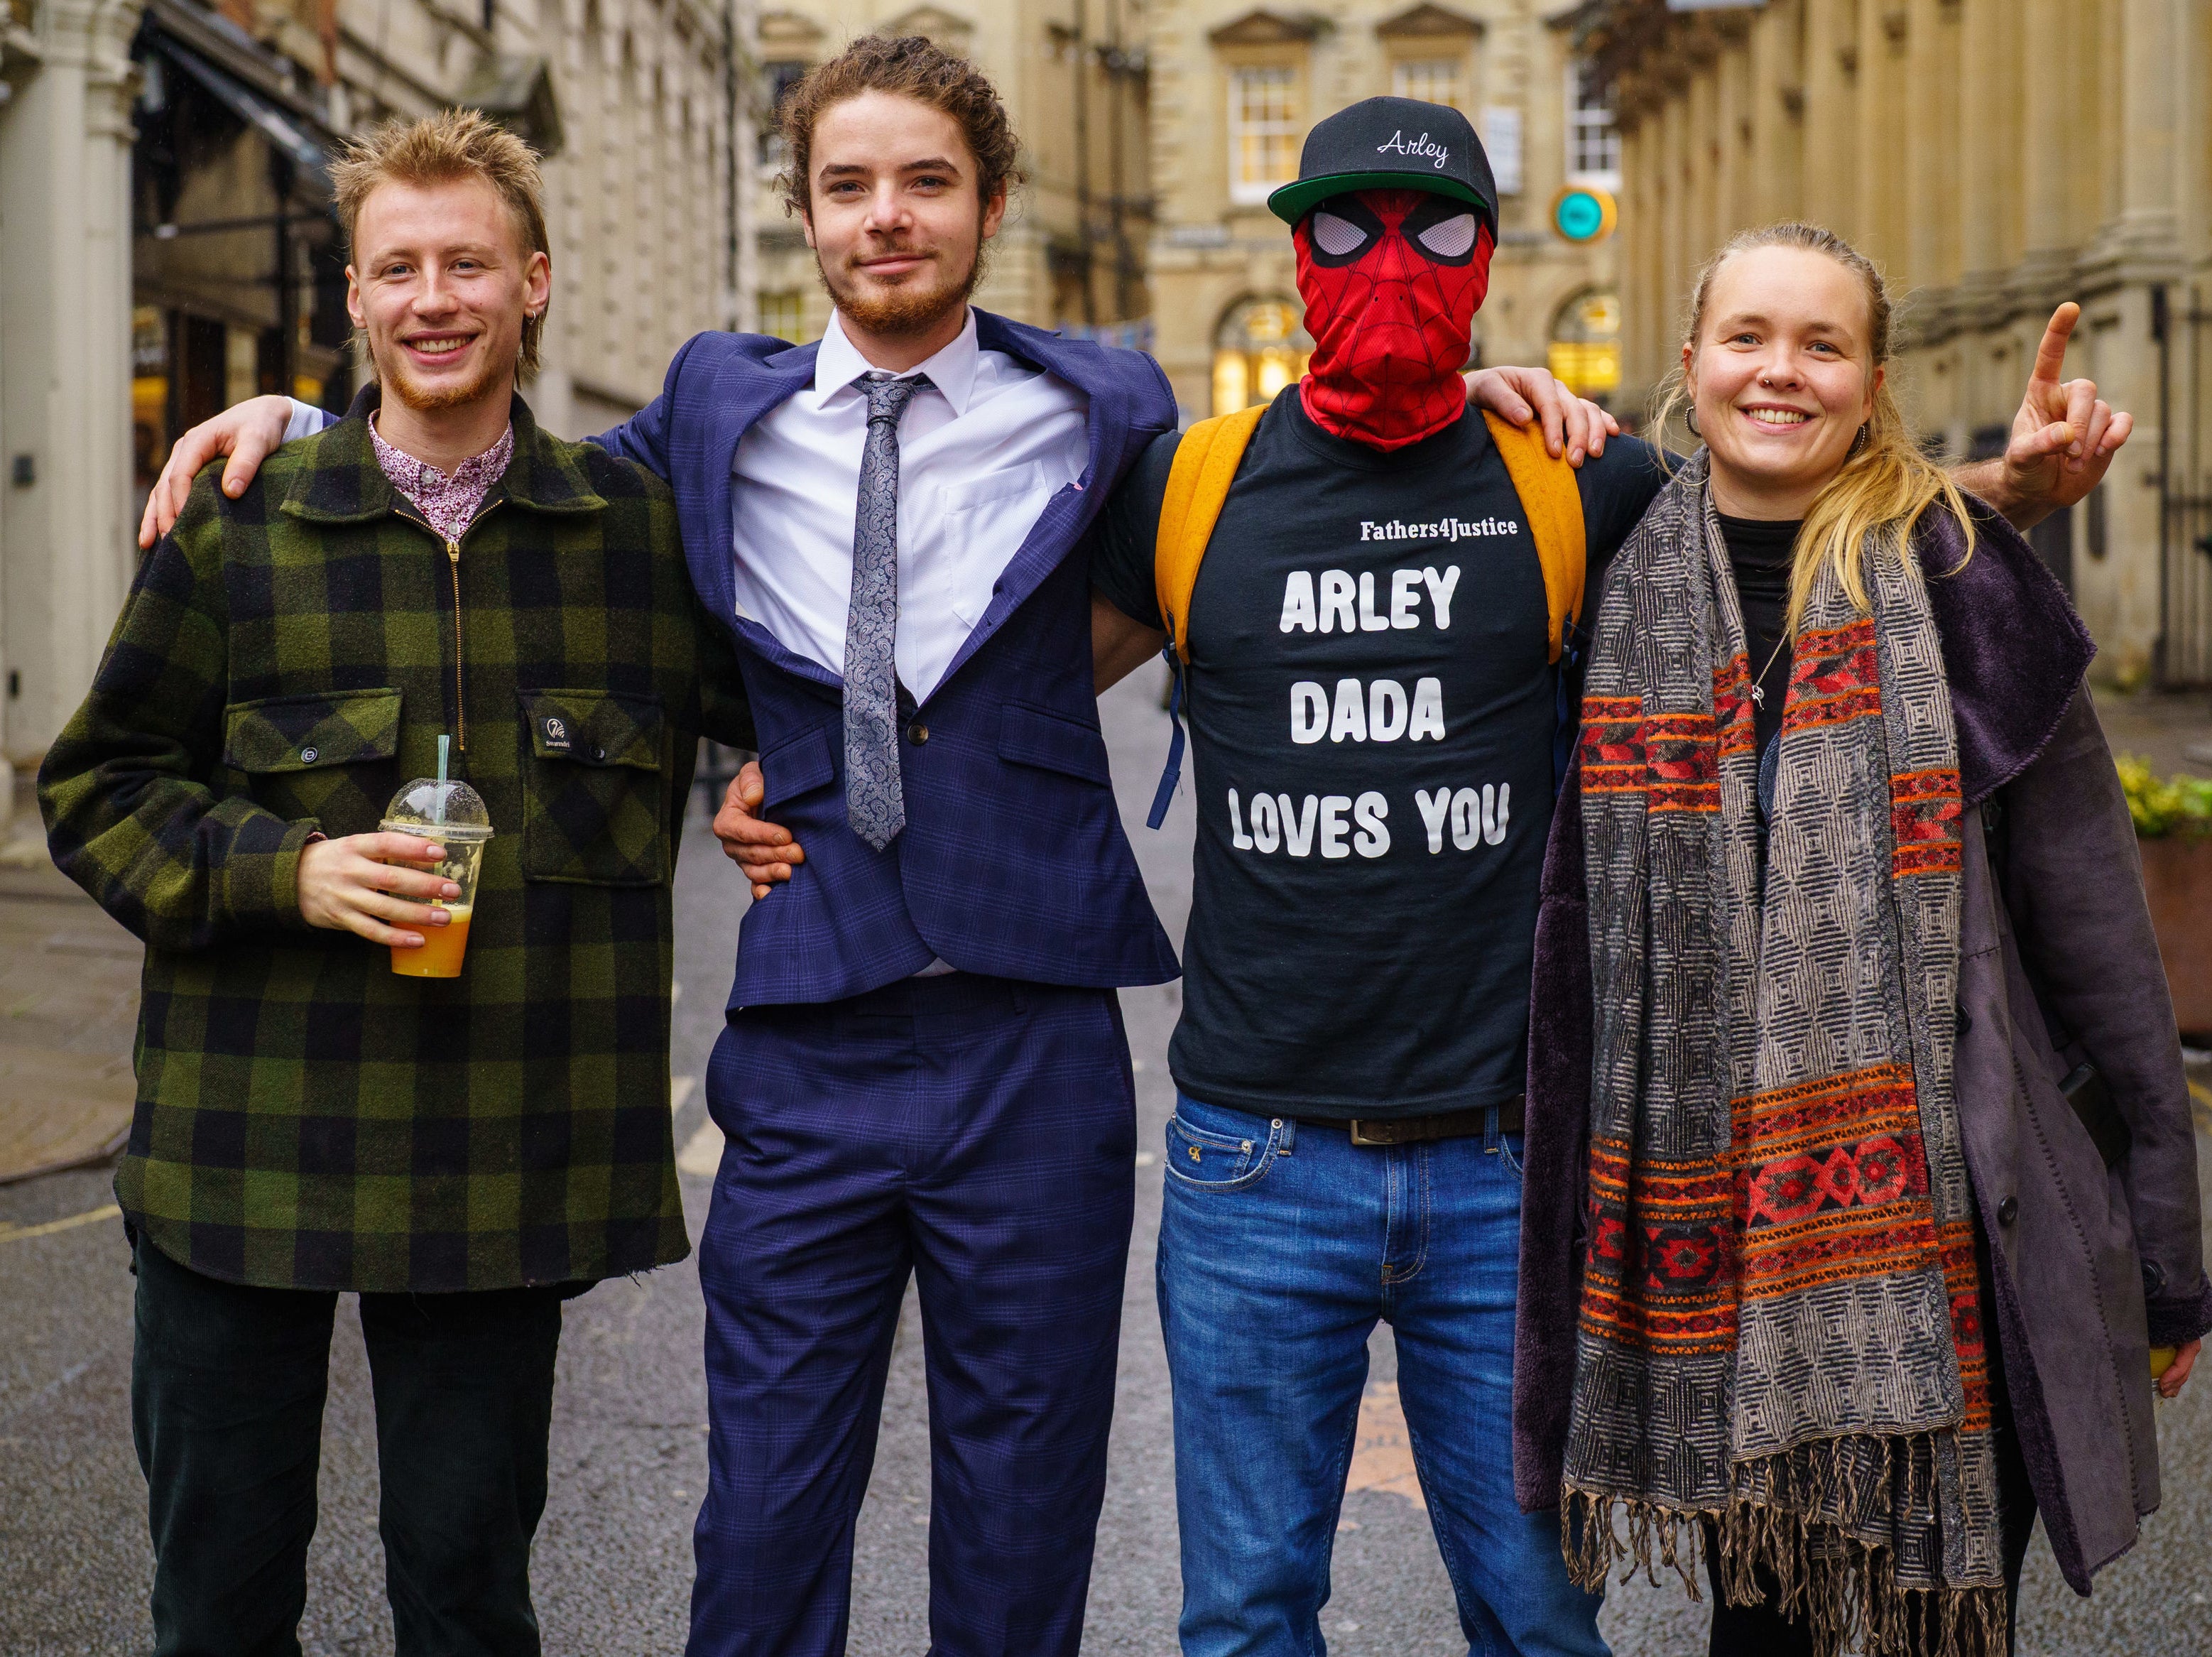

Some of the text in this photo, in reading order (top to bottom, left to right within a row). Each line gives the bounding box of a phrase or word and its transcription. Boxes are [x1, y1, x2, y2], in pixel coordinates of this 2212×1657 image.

[1377, 129, 1449, 169] Arley
[1360, 516, 1518, 542] Fathers4Justice
[1279, 565, 1461, 634] ARLEY
[1290, 677, 1446, 744] DADA
[1228, 782, 1510, 859] LOVES YOU
